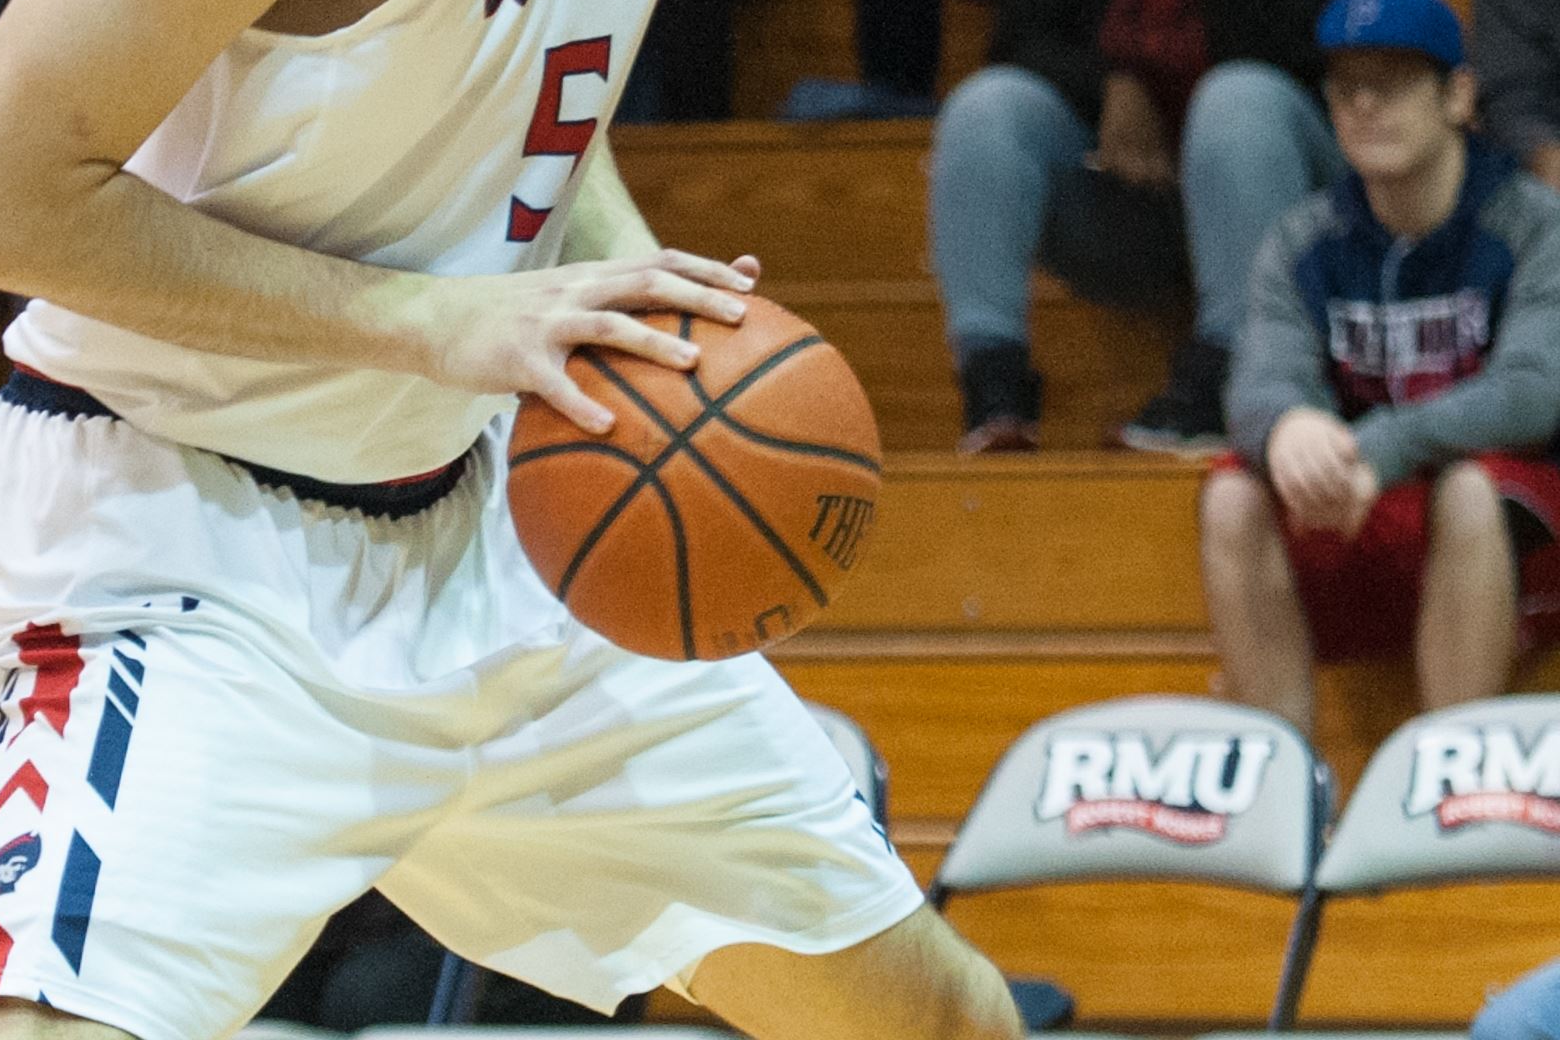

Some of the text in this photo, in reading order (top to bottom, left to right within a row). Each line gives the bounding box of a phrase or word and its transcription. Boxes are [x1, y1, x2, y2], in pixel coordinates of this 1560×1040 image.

[506, 35, 612, 242] 5
[1036, 728, 1272, 820] RMU
[1403, 728, 1560, 819] RM
